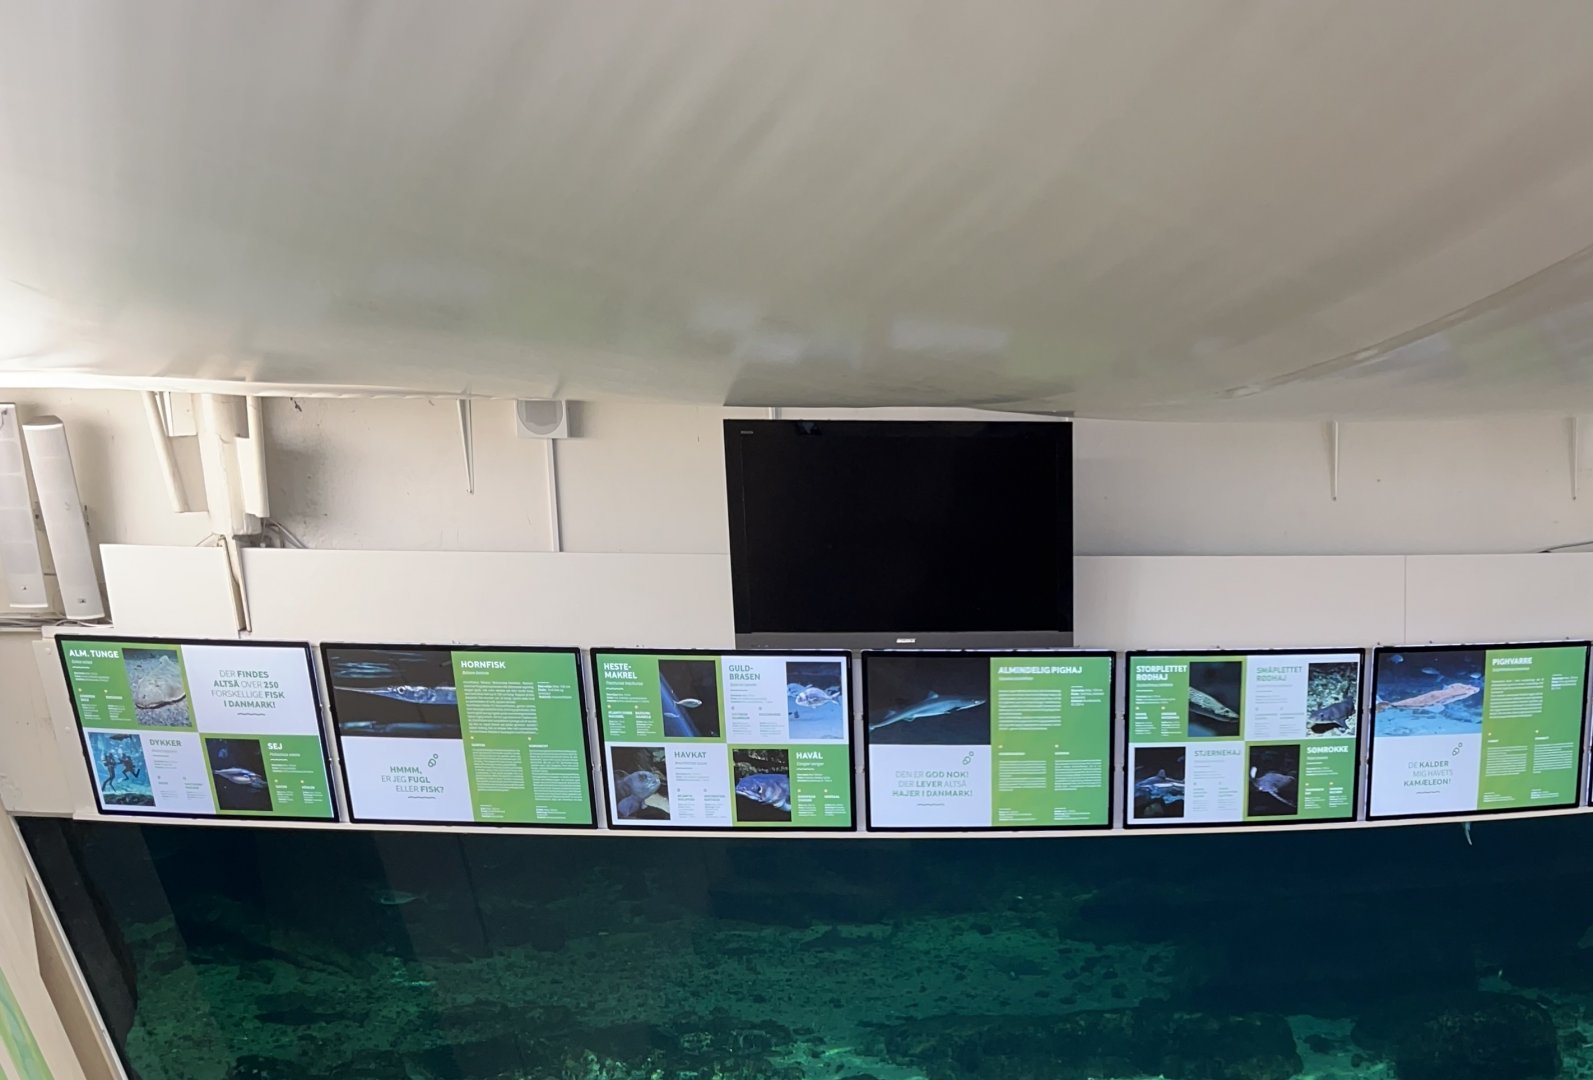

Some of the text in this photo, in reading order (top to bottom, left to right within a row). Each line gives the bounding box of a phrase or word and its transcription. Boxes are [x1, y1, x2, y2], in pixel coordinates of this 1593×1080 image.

[69, 649, 119, 659] ALM. TUNGE
[461, 660, 506, 669] HORNFISK
[603, 663, 631, 671] HESTE-
[728, 664, 754, 672] GULD-
[997, 666, 1083, 674] ALMINDELIG PIGHAJ
[1136, 665, 1188, 674] STORPLETTET
[219, 670, 269, 679] DER FINDES
[604, 671, 638, 679] MAKREL
[729, 673, 760, 681] BRASEN
[213, 679, 279, 689] ALTSÅ OVER 250
[210, 690, 286, 699] FORSKELLIGE FISK
[224, 700, 276, 709] I DANMARK!
[149, 739, 182, 747] DYKKER
[267, 742, 283, 750] SEJ
[674, 751, 707, 759] HAVKAT
[796, 751, 824, 760] HAVÅL
[1419, 760, 1449, 769] KALDER
[390, 766, 422, 775] HMMM,
[946, 770, 969, 778] NOK!
[408, 776, 431, 784] FUGL
[916, 780, 943, 788] LEVER
[396, 785, 444, 793] ELLER FISK?
[892, 789, 920, 797] HAJER
[927, 789, 973, 797] DANMARK!
